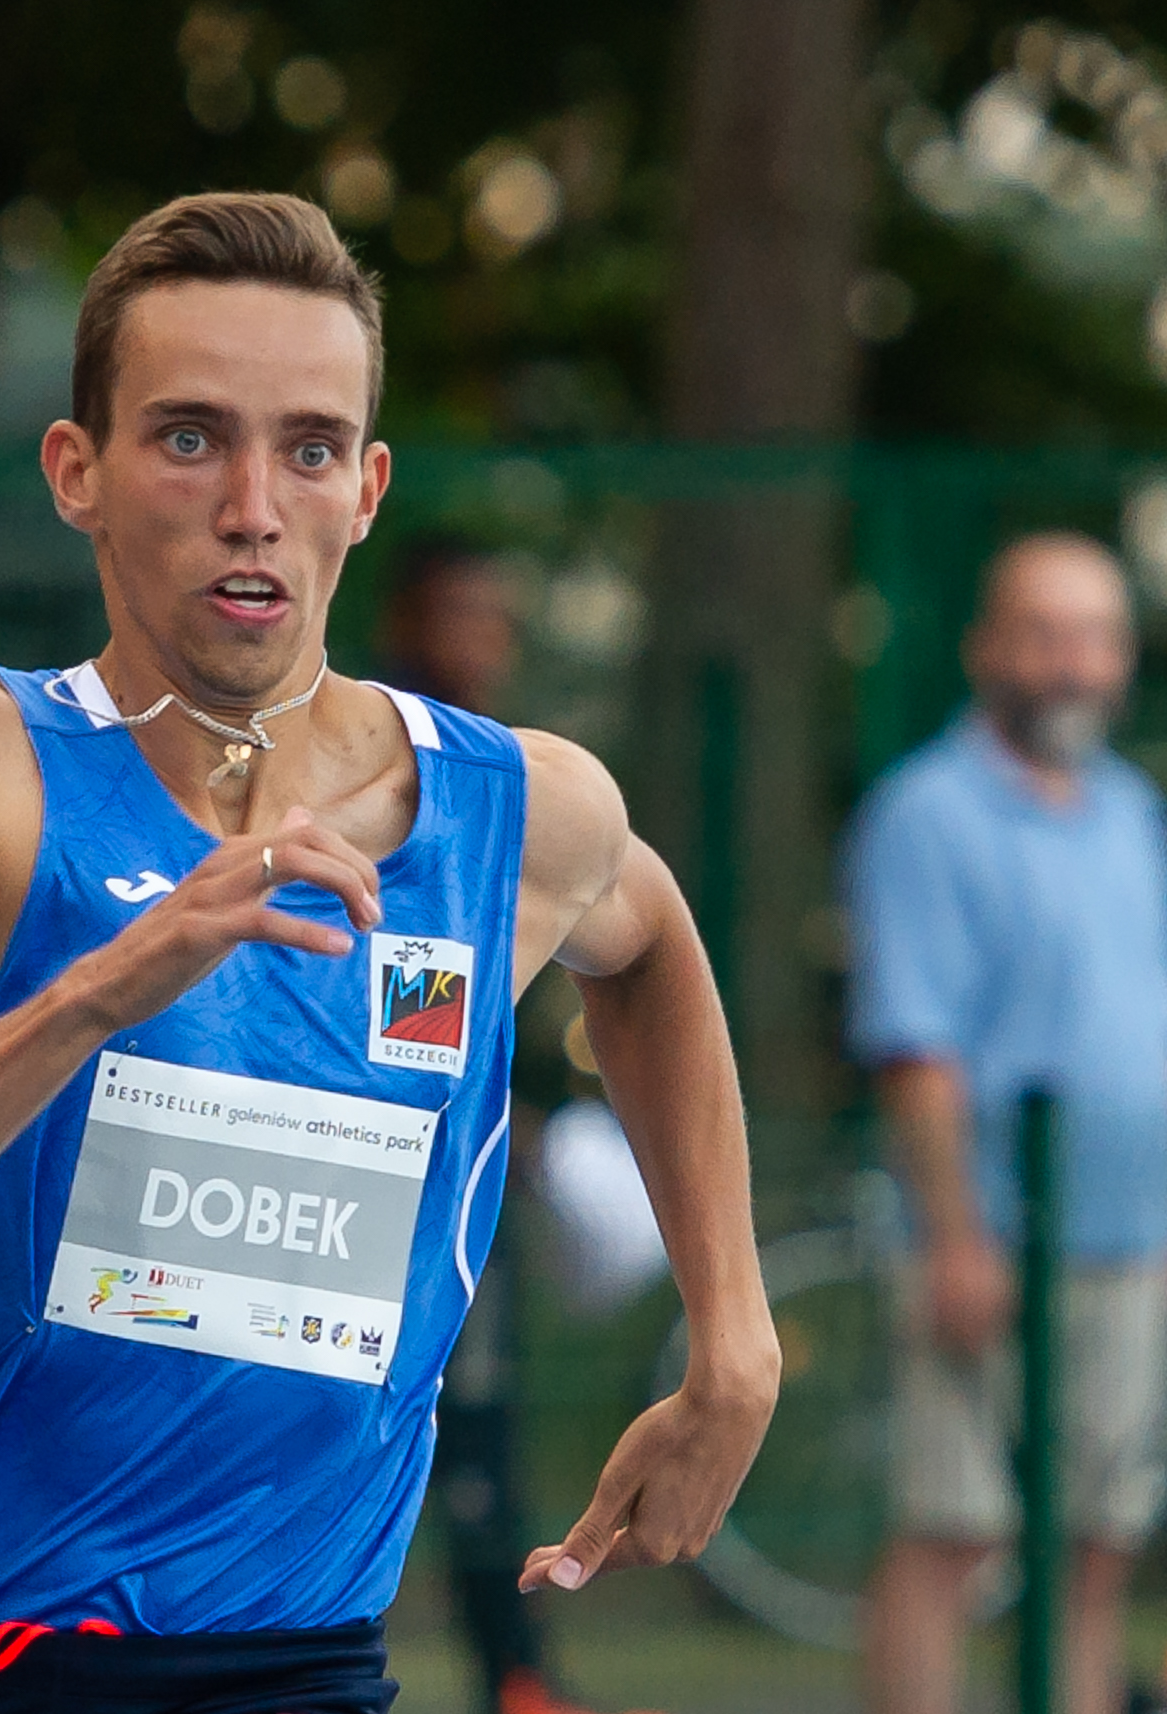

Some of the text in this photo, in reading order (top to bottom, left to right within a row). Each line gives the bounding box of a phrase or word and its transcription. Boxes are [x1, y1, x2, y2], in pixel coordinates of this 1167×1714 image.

[105, 1083, 425, 1153] BESTSELLER goleniów athletics park
[138, 1167, 359, 1260] DOBEK
[165, 1272, 205, 1290] DUET
